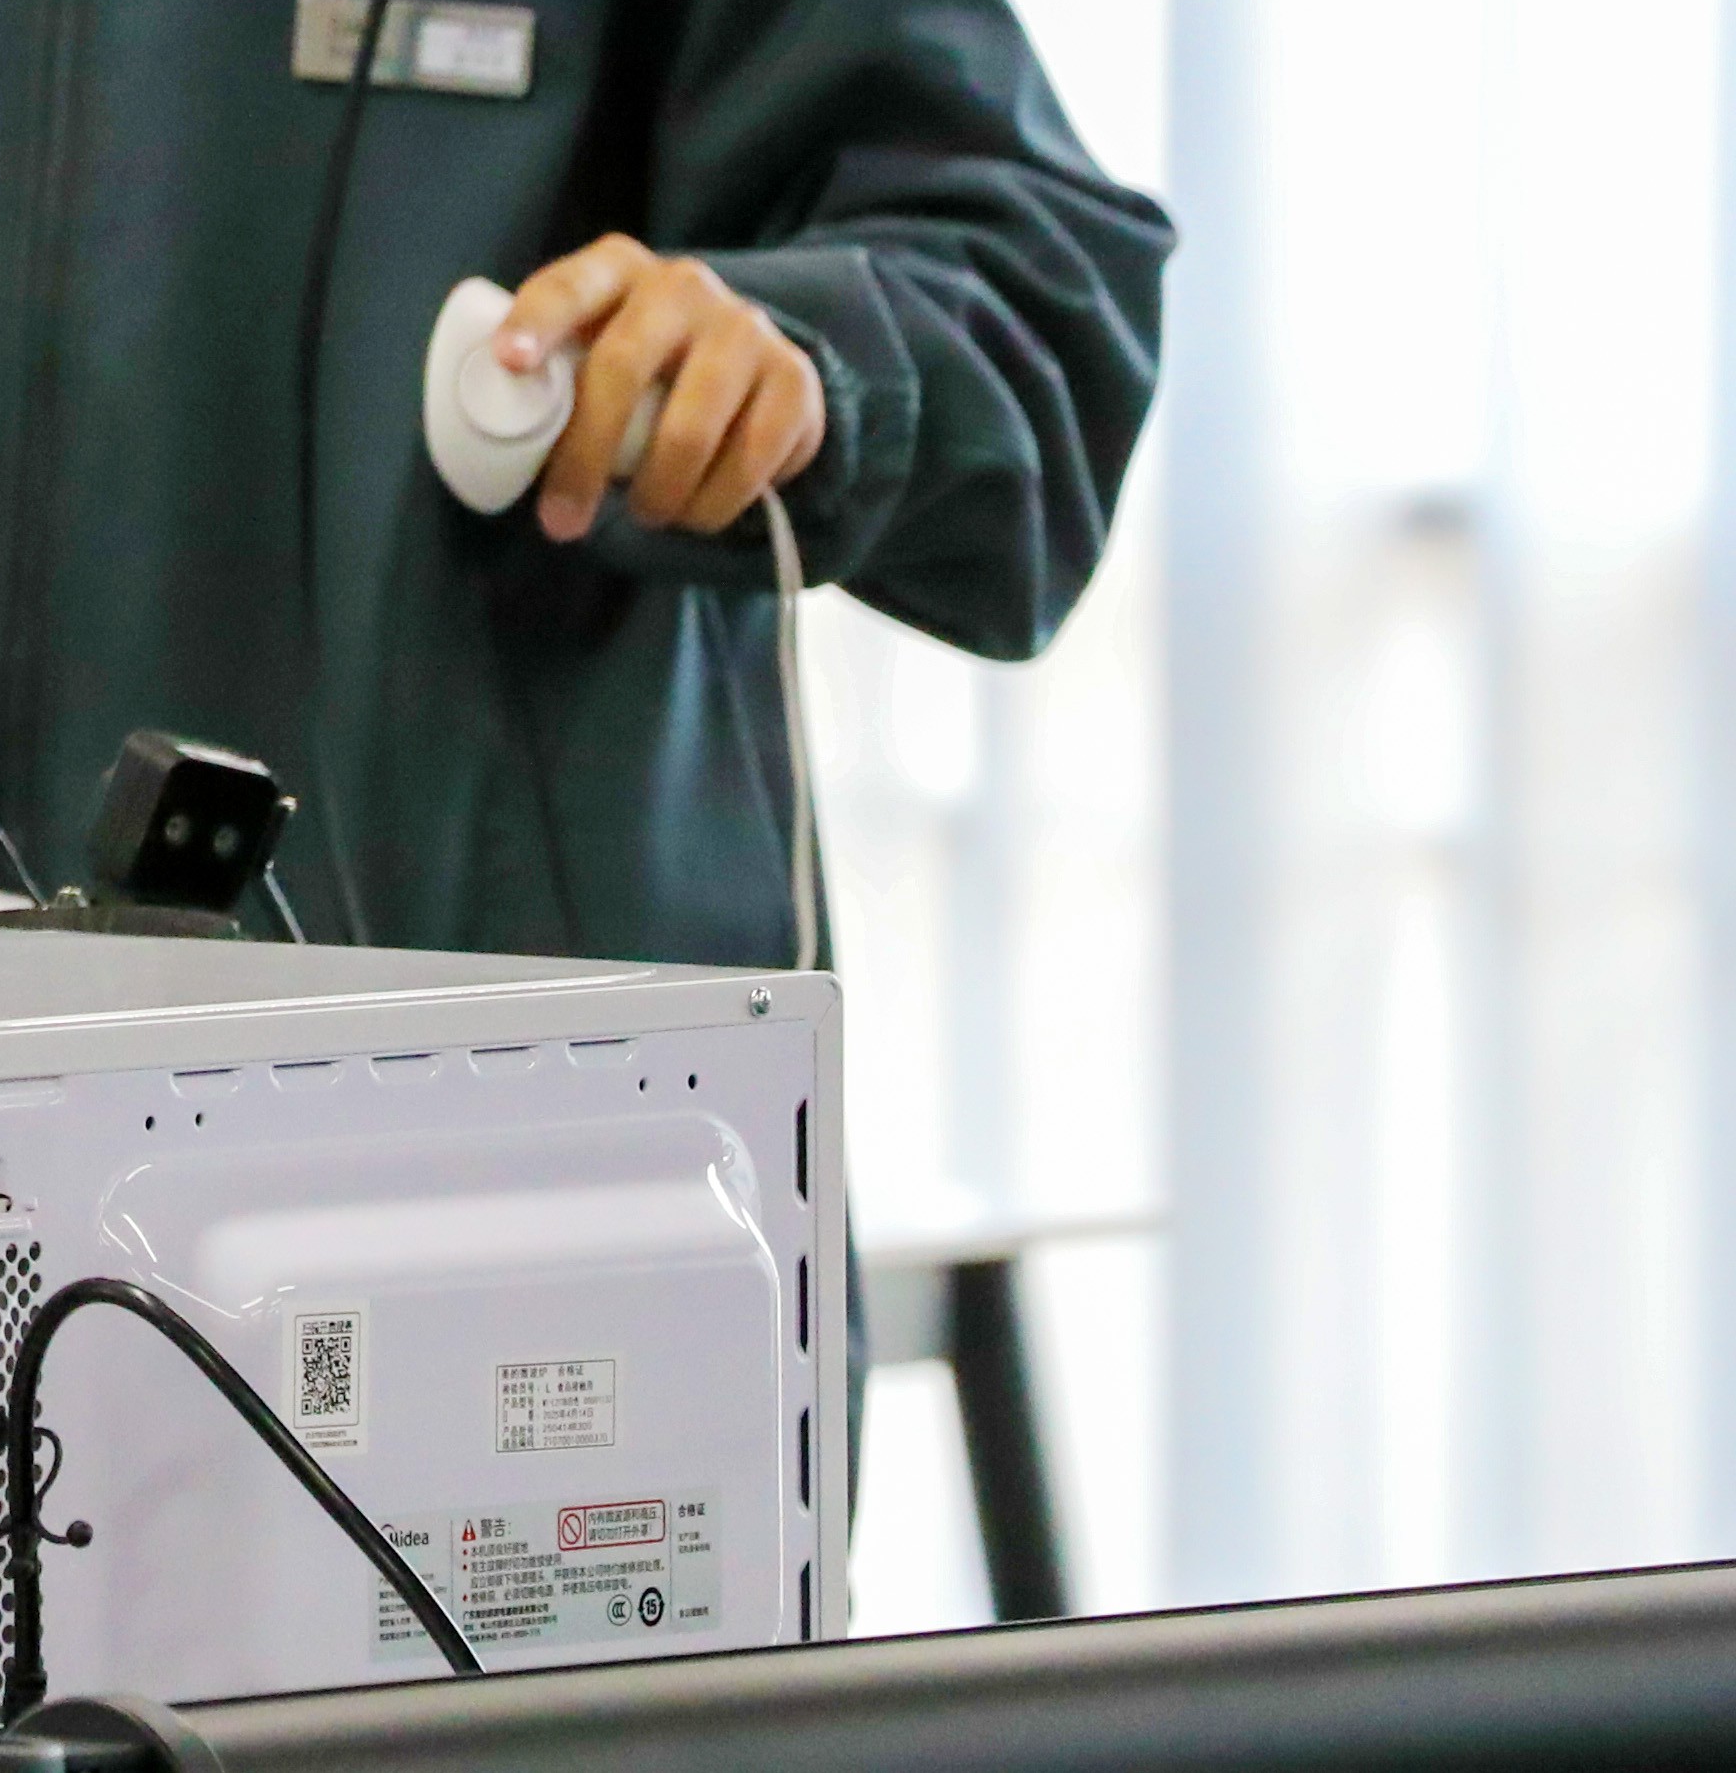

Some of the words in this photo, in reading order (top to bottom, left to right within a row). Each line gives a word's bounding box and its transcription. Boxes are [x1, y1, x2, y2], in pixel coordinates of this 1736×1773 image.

[678, 1502, 706, 1518] 合格证
[645, 1598, 658, 1616] 15
